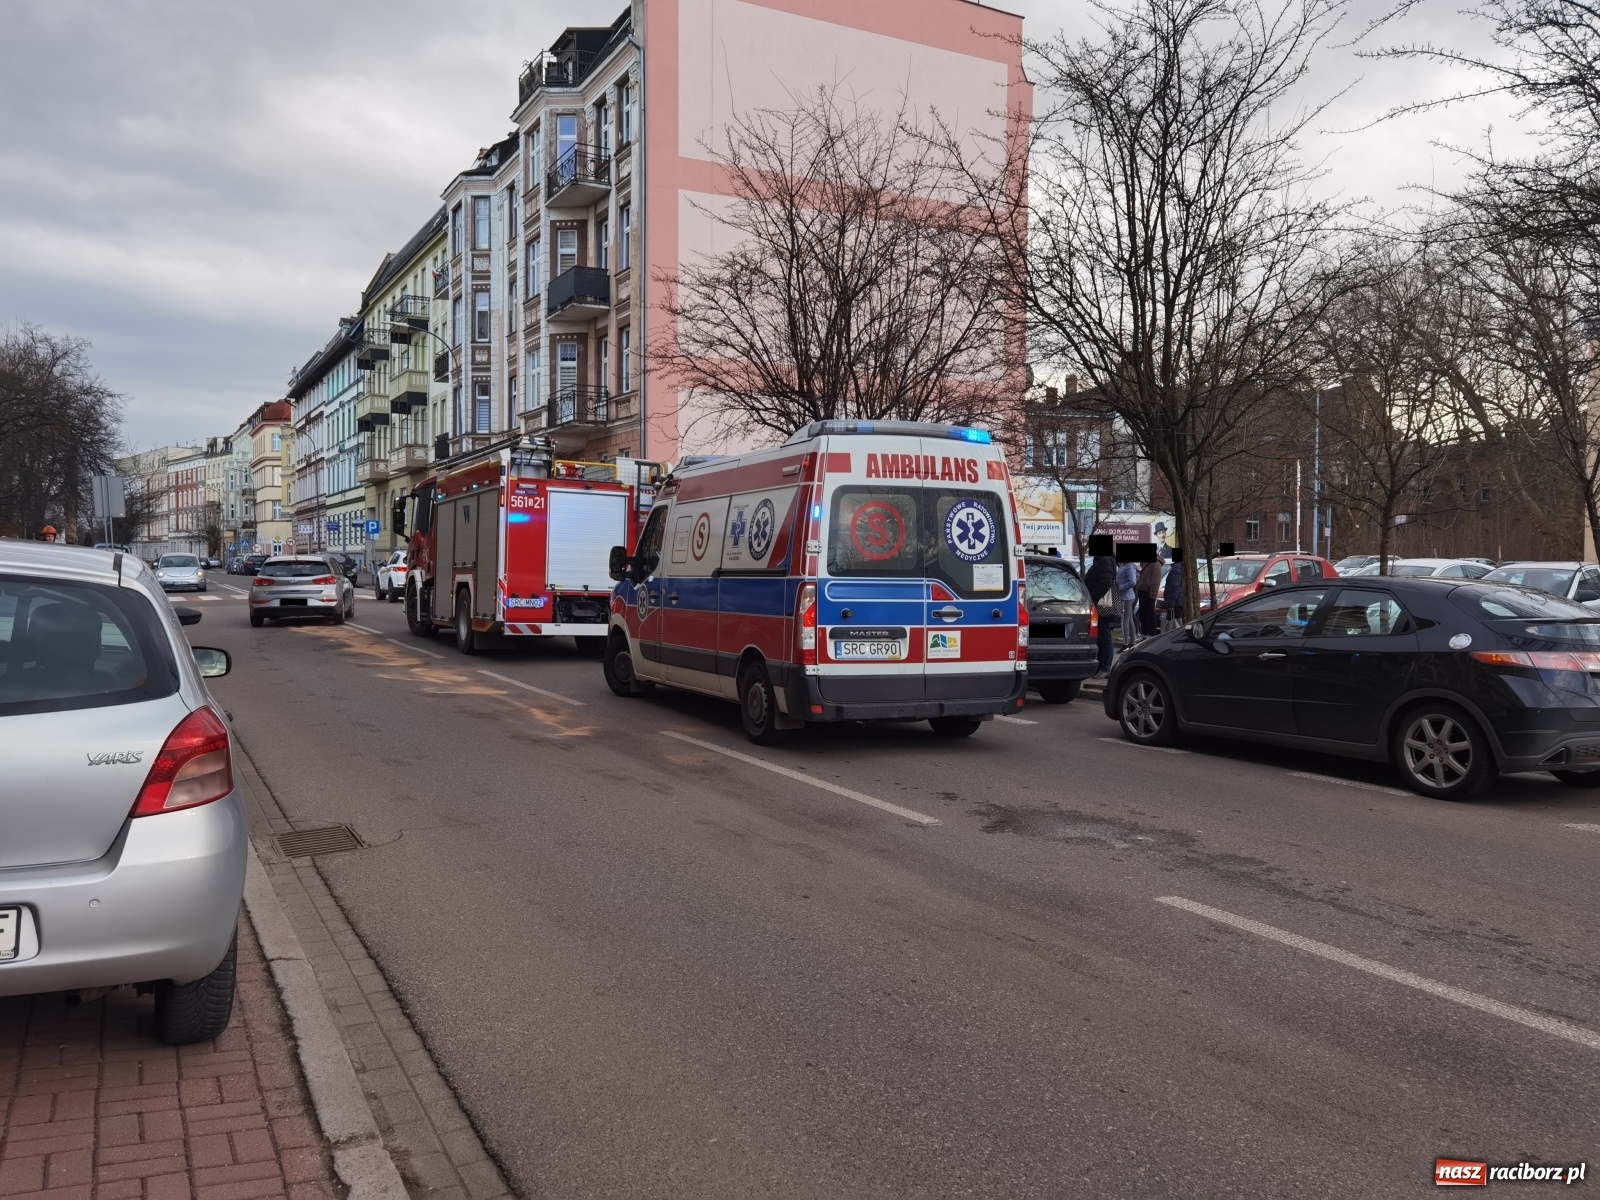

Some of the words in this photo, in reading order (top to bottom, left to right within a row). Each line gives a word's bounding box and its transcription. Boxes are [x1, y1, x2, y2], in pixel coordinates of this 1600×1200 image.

[866, 453, 979, 484] AMBULANS
[945, 502, 966, 544] PAŃSTWOWE
[973, 501, 996, 544] RATOWNICTWO
[1023, 523, 1036, 531] Twój
[1037, 523, 1060, 531] problem
[955, 549, 989, 561] MEDYCZNE
[843, 643, 866, 655] SRC
[869, 643, 897, 655] GR90
[87, 751, 144, 766] YARIS
